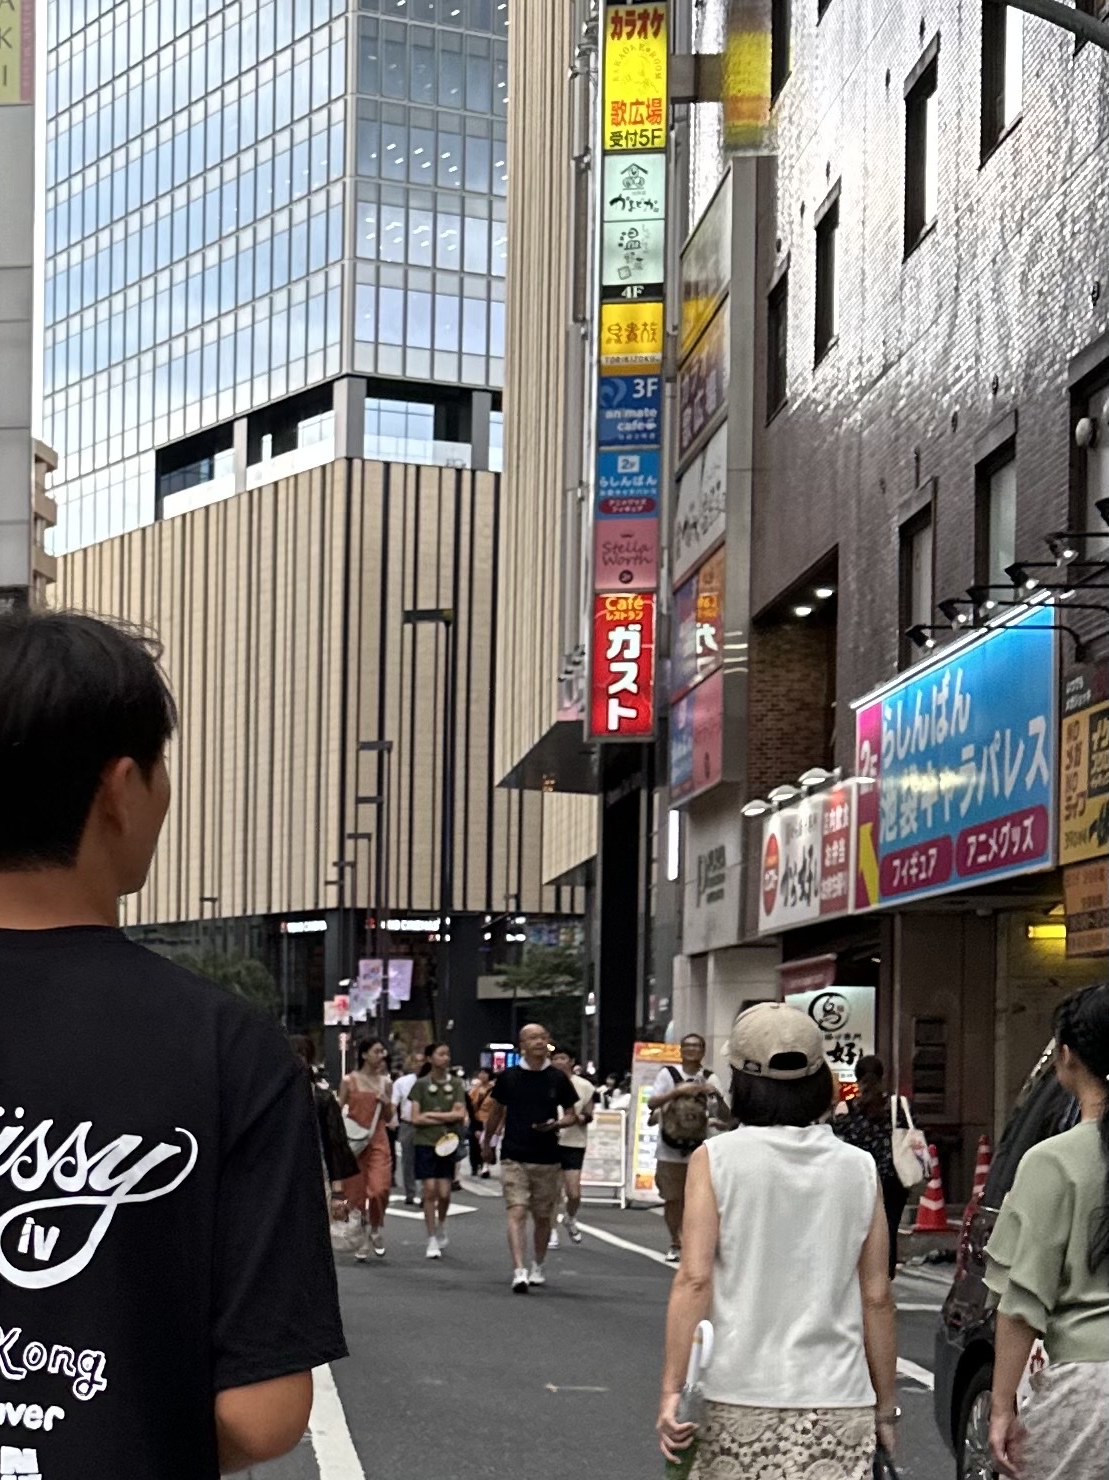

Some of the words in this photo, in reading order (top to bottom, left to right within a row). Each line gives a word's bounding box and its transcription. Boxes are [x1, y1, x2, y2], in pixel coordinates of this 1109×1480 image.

[610, 6, 665, 41] カラオケ
[610, 97, 663, 127] 歌広場
[610, 128, 663, 149] 受付5F
[621, 285, 645, 300] 4F
[632, 377, 659, 399] 3F
[606, 623, 642, 732] ガスト
[882, 667, 971, 768] らしんばん
[966, 815, 1035, 867] アニメグッズ
